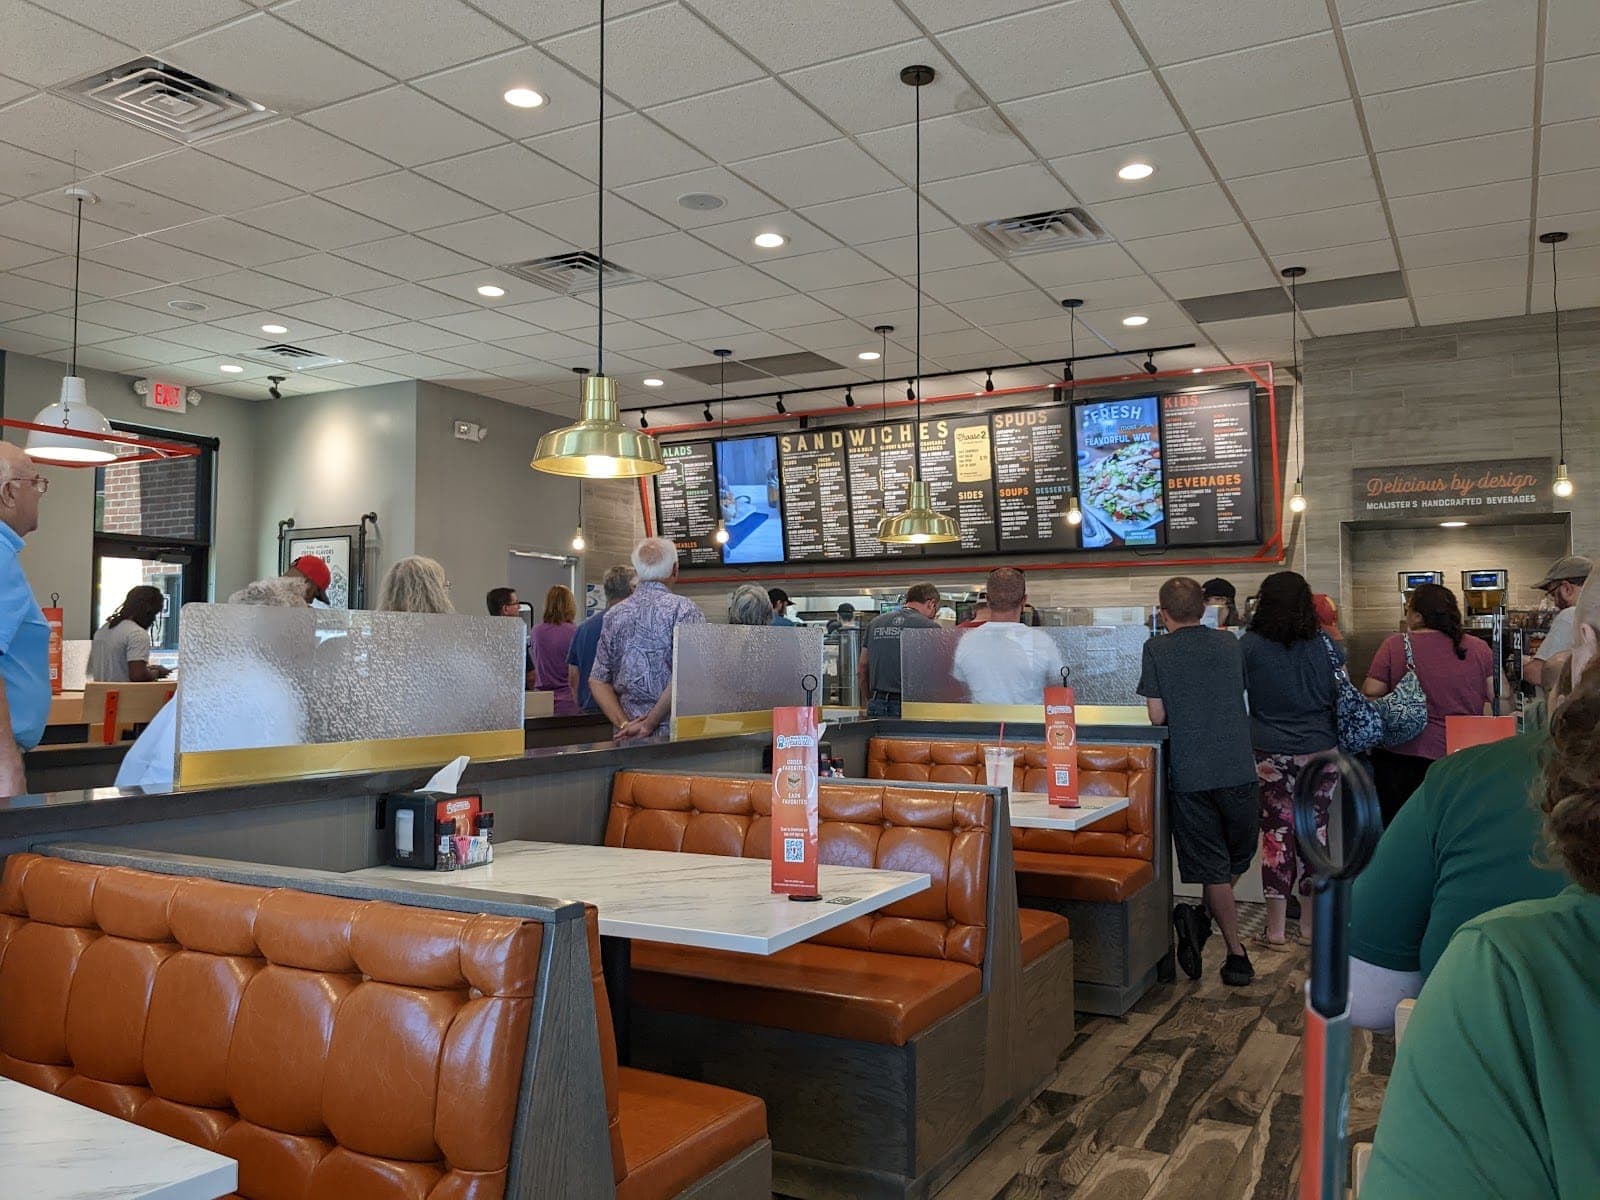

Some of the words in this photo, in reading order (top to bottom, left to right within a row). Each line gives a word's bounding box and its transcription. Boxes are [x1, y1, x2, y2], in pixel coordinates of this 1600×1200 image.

[155, 383, 180, 407] EXIT
[1164, 396, 1199, 409] KIDS
[994, 410, 1048, 428] SPUDS
[1090, 405, 1142, 424] FRESH
[781, 421, 948, 453] SANDWICHES
[1085, 435, 1130, 446] FLAVORFUL
[1132, 432, 1151, 441] WAY
[662, 446, 693, 458] ALADS
[1168, 474, 1242, 489] BEVERAGES
[1367, 476, 1447, 497] Delicious
[1450, 473, 1474, 496] by
[1477, 471, 1537, 494] design
[957, 491, 984, 500] SIDES
[999, 488, 1029, 497] SOUPS
[1035, 485, 1072, 495] DESSERTS
[1366, 500, 1418, 510] MCALISTER'S
[1421, 497, 1482, 508] HANDCRAFTED
[1486, 494, 1537, 505] BEVERAGES
[1513, 632, 1520, 649] 22
